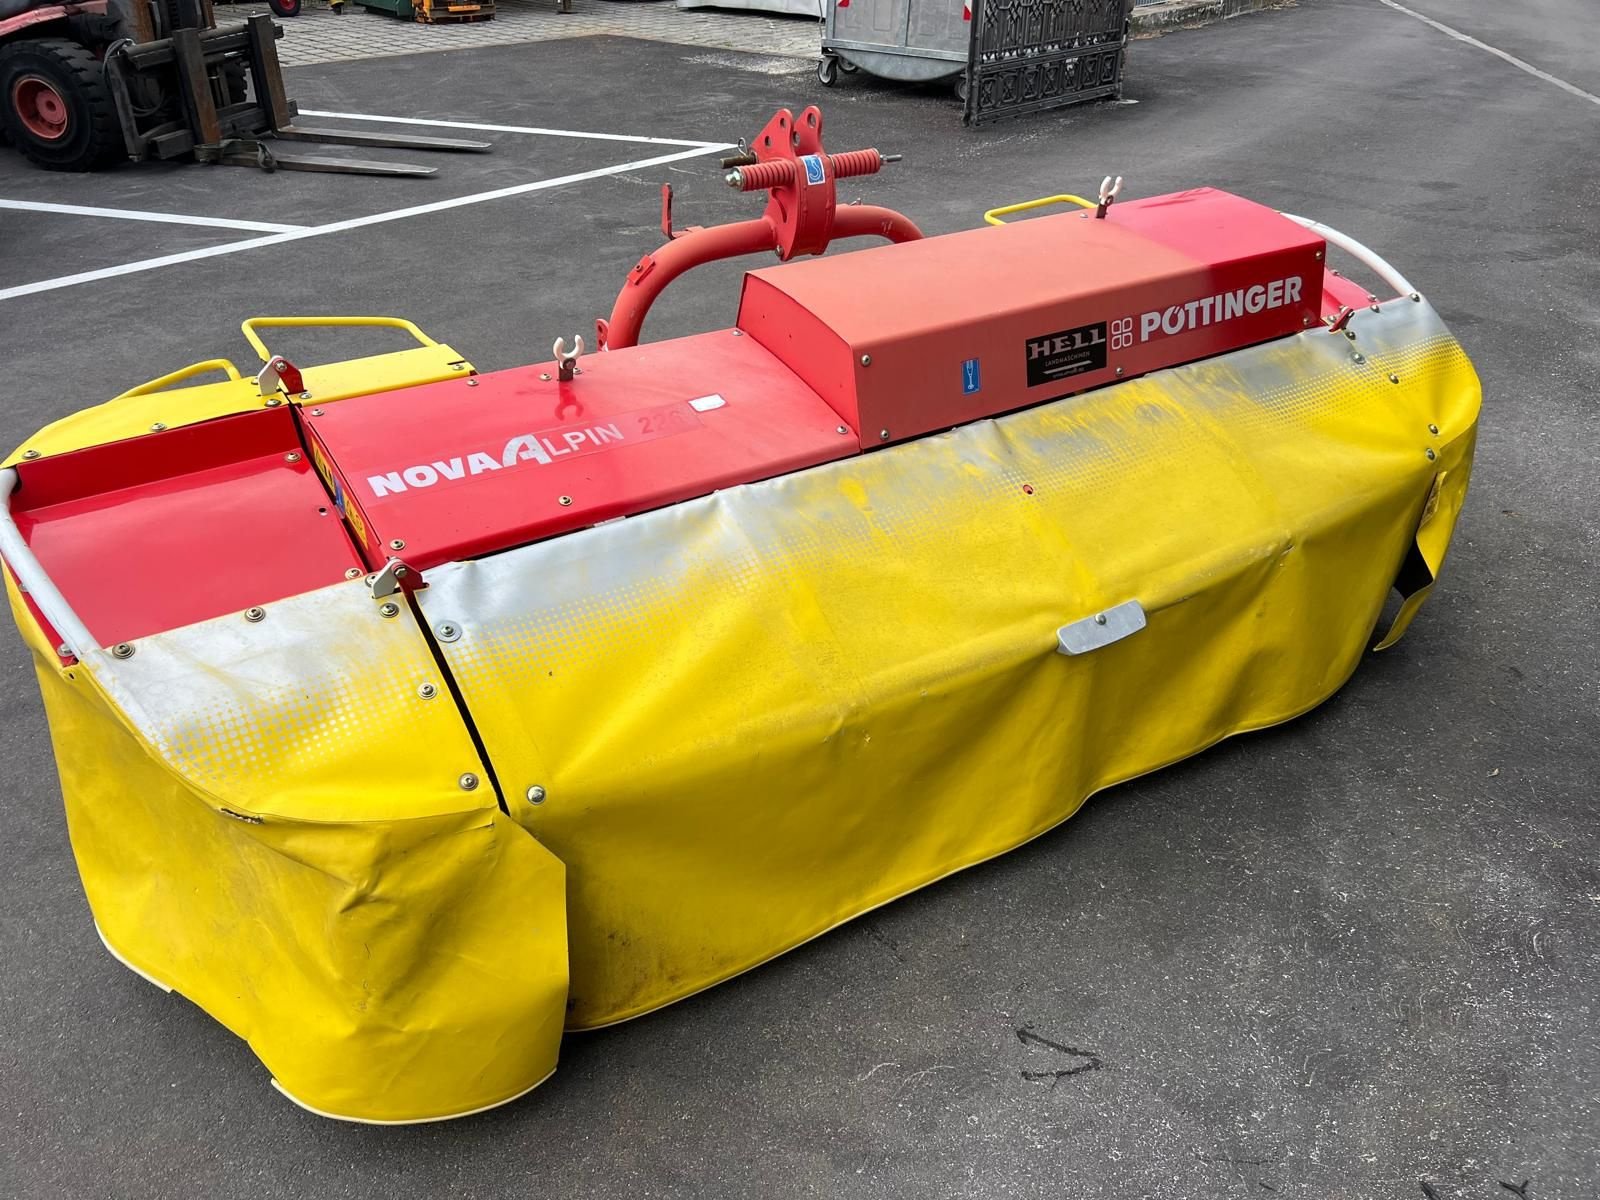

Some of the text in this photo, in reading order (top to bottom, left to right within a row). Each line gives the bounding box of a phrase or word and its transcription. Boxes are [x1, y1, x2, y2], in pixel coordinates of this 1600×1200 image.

[1140, 276, 1302, 342] PÖTTINGER
[1028, 329, 1106, 360] HELL
[1044, 351, 1091, 367] LANDMASCHINEN
